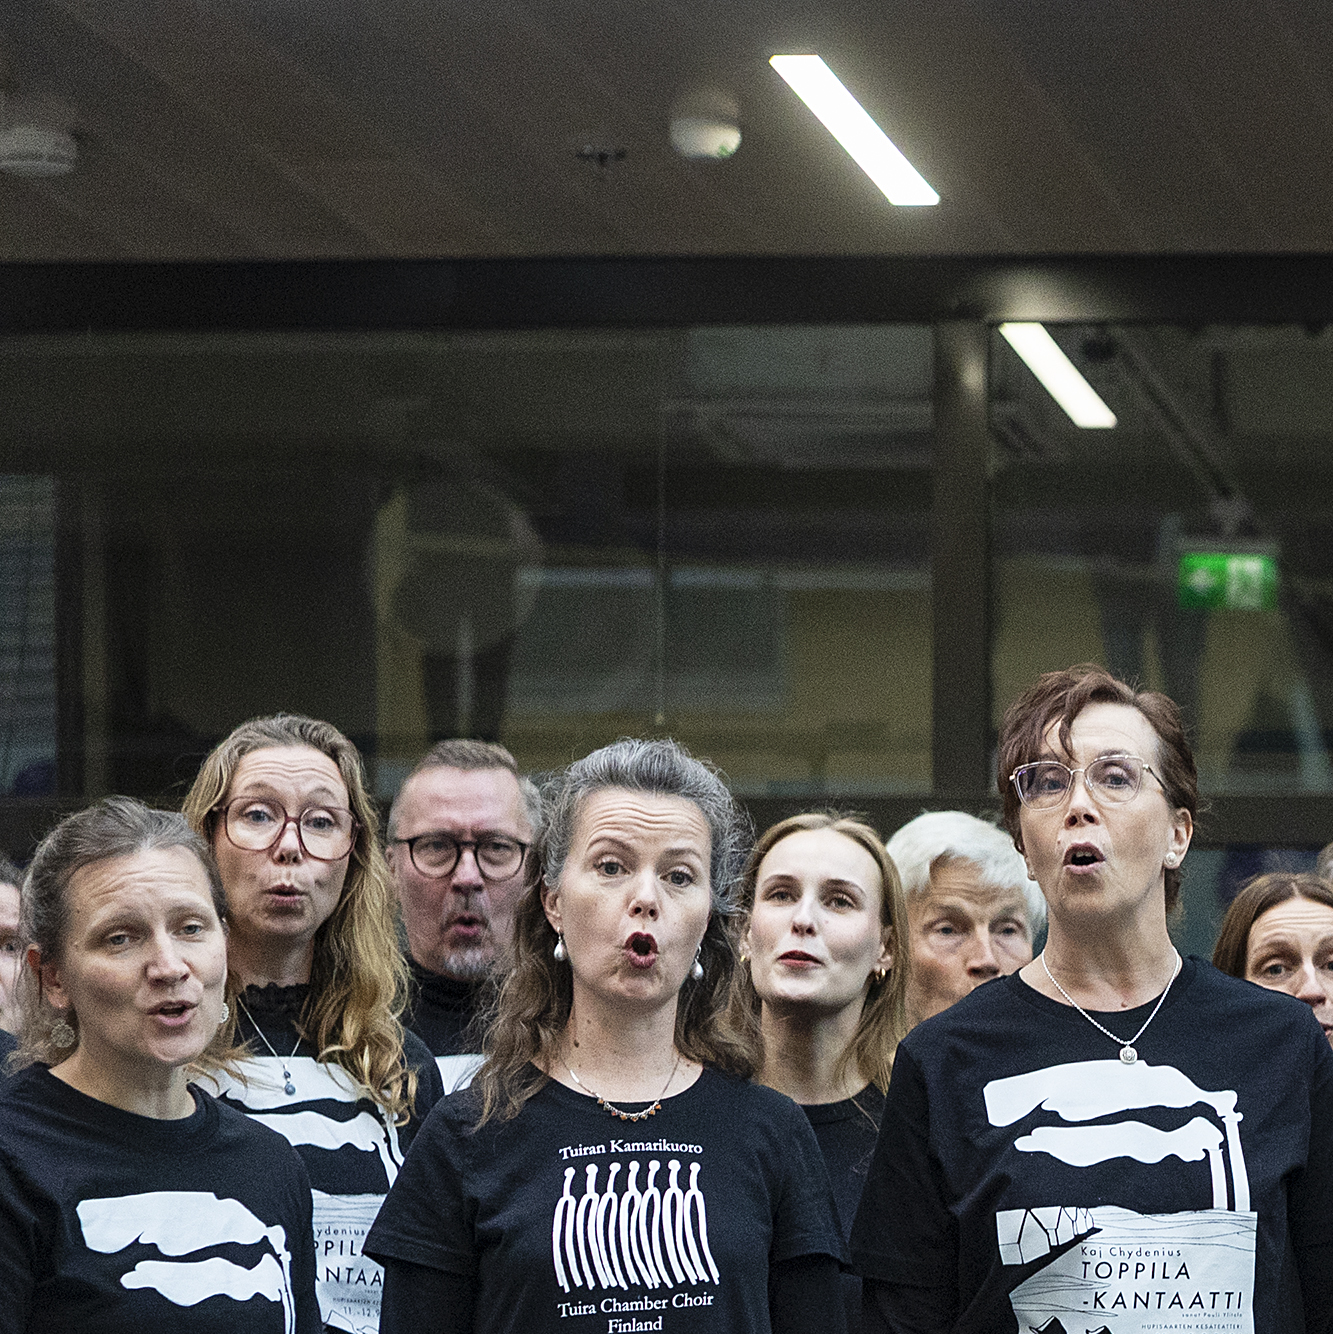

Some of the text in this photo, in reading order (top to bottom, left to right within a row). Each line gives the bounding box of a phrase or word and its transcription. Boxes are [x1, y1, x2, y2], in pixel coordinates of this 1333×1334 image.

[559, 1138, 703, 1160] Tuiran Kamarikuoro
[1080, 1246, 1182, 1260] Kaj Chydenius
[1081, 1261, 1191, 1280] TOPPILA
[556, 1291, 714, 1318] Tuira Chamber Choir
[1082, 1291, 1243, 1310] -KANTAATTI
[607, 1316, 663, 1334] Finland
